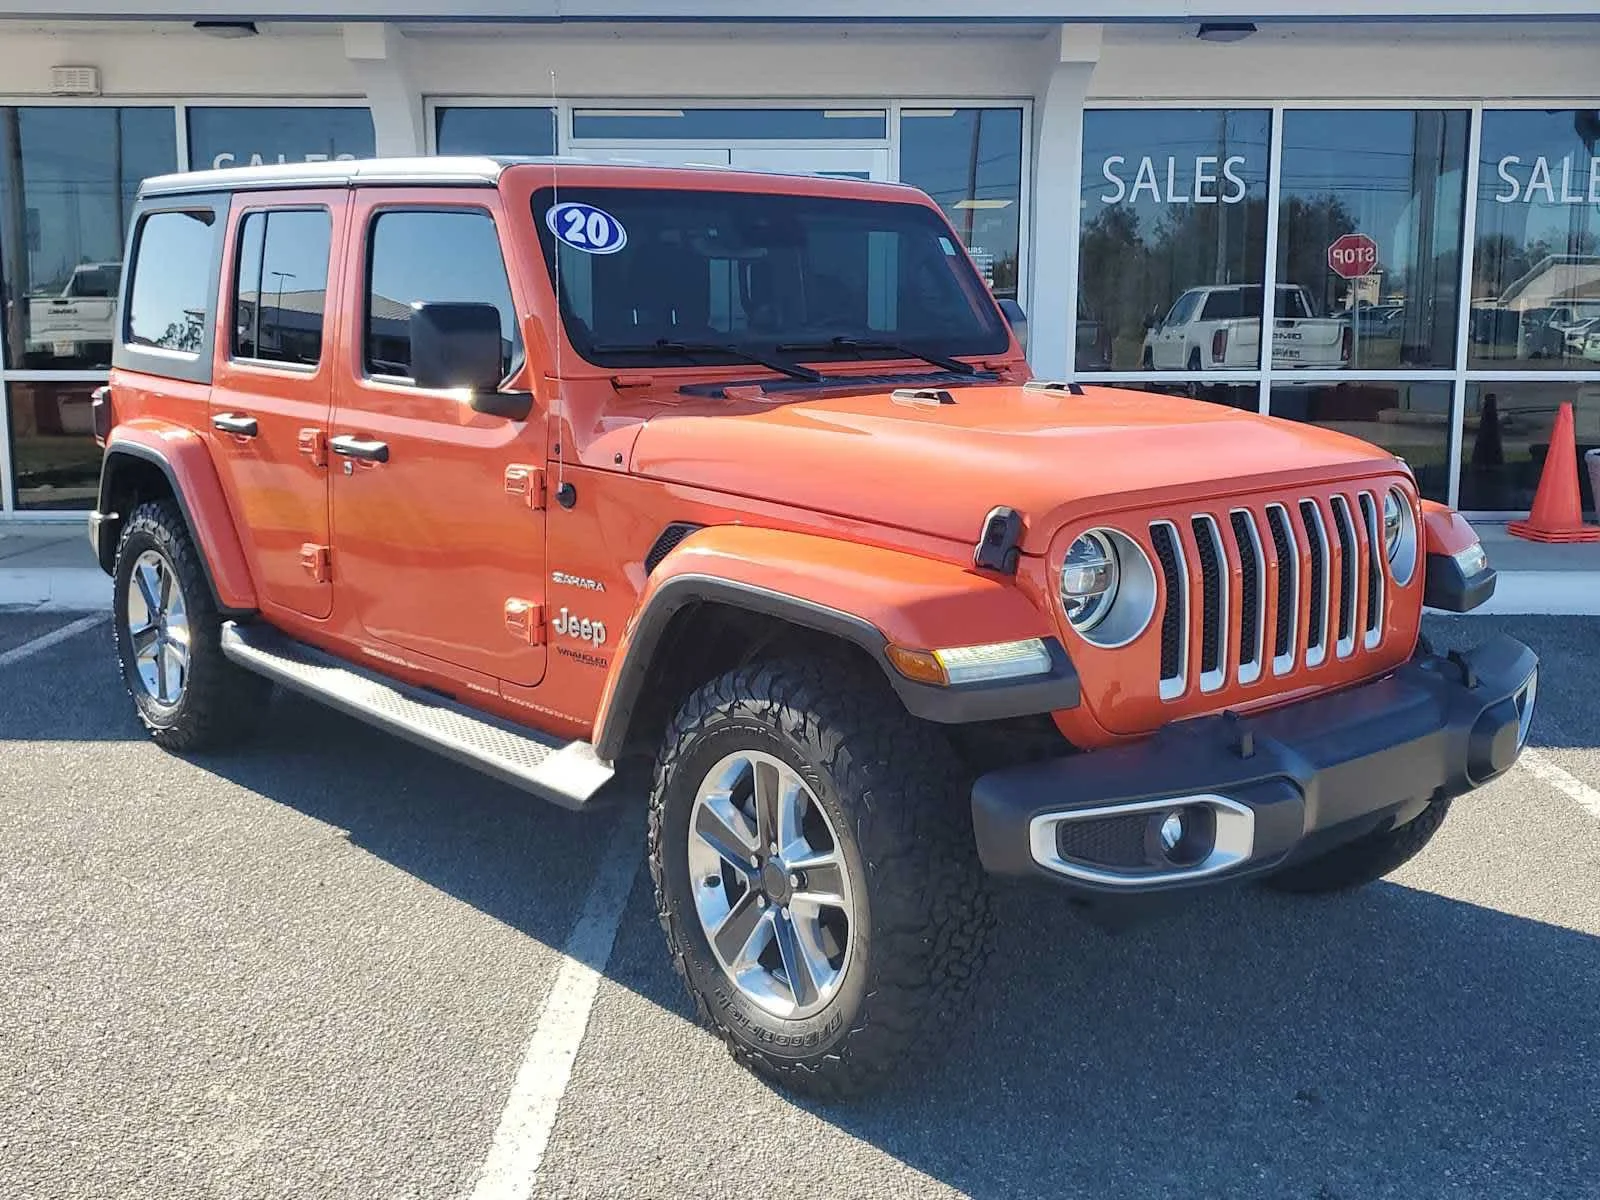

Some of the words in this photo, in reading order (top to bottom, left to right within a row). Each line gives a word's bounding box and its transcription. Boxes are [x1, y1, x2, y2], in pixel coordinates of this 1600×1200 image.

[1101, 155, 1246, 204] SALES
[564, 208, 609, 247] 20
[552, 607, 607, 648] Jeep
